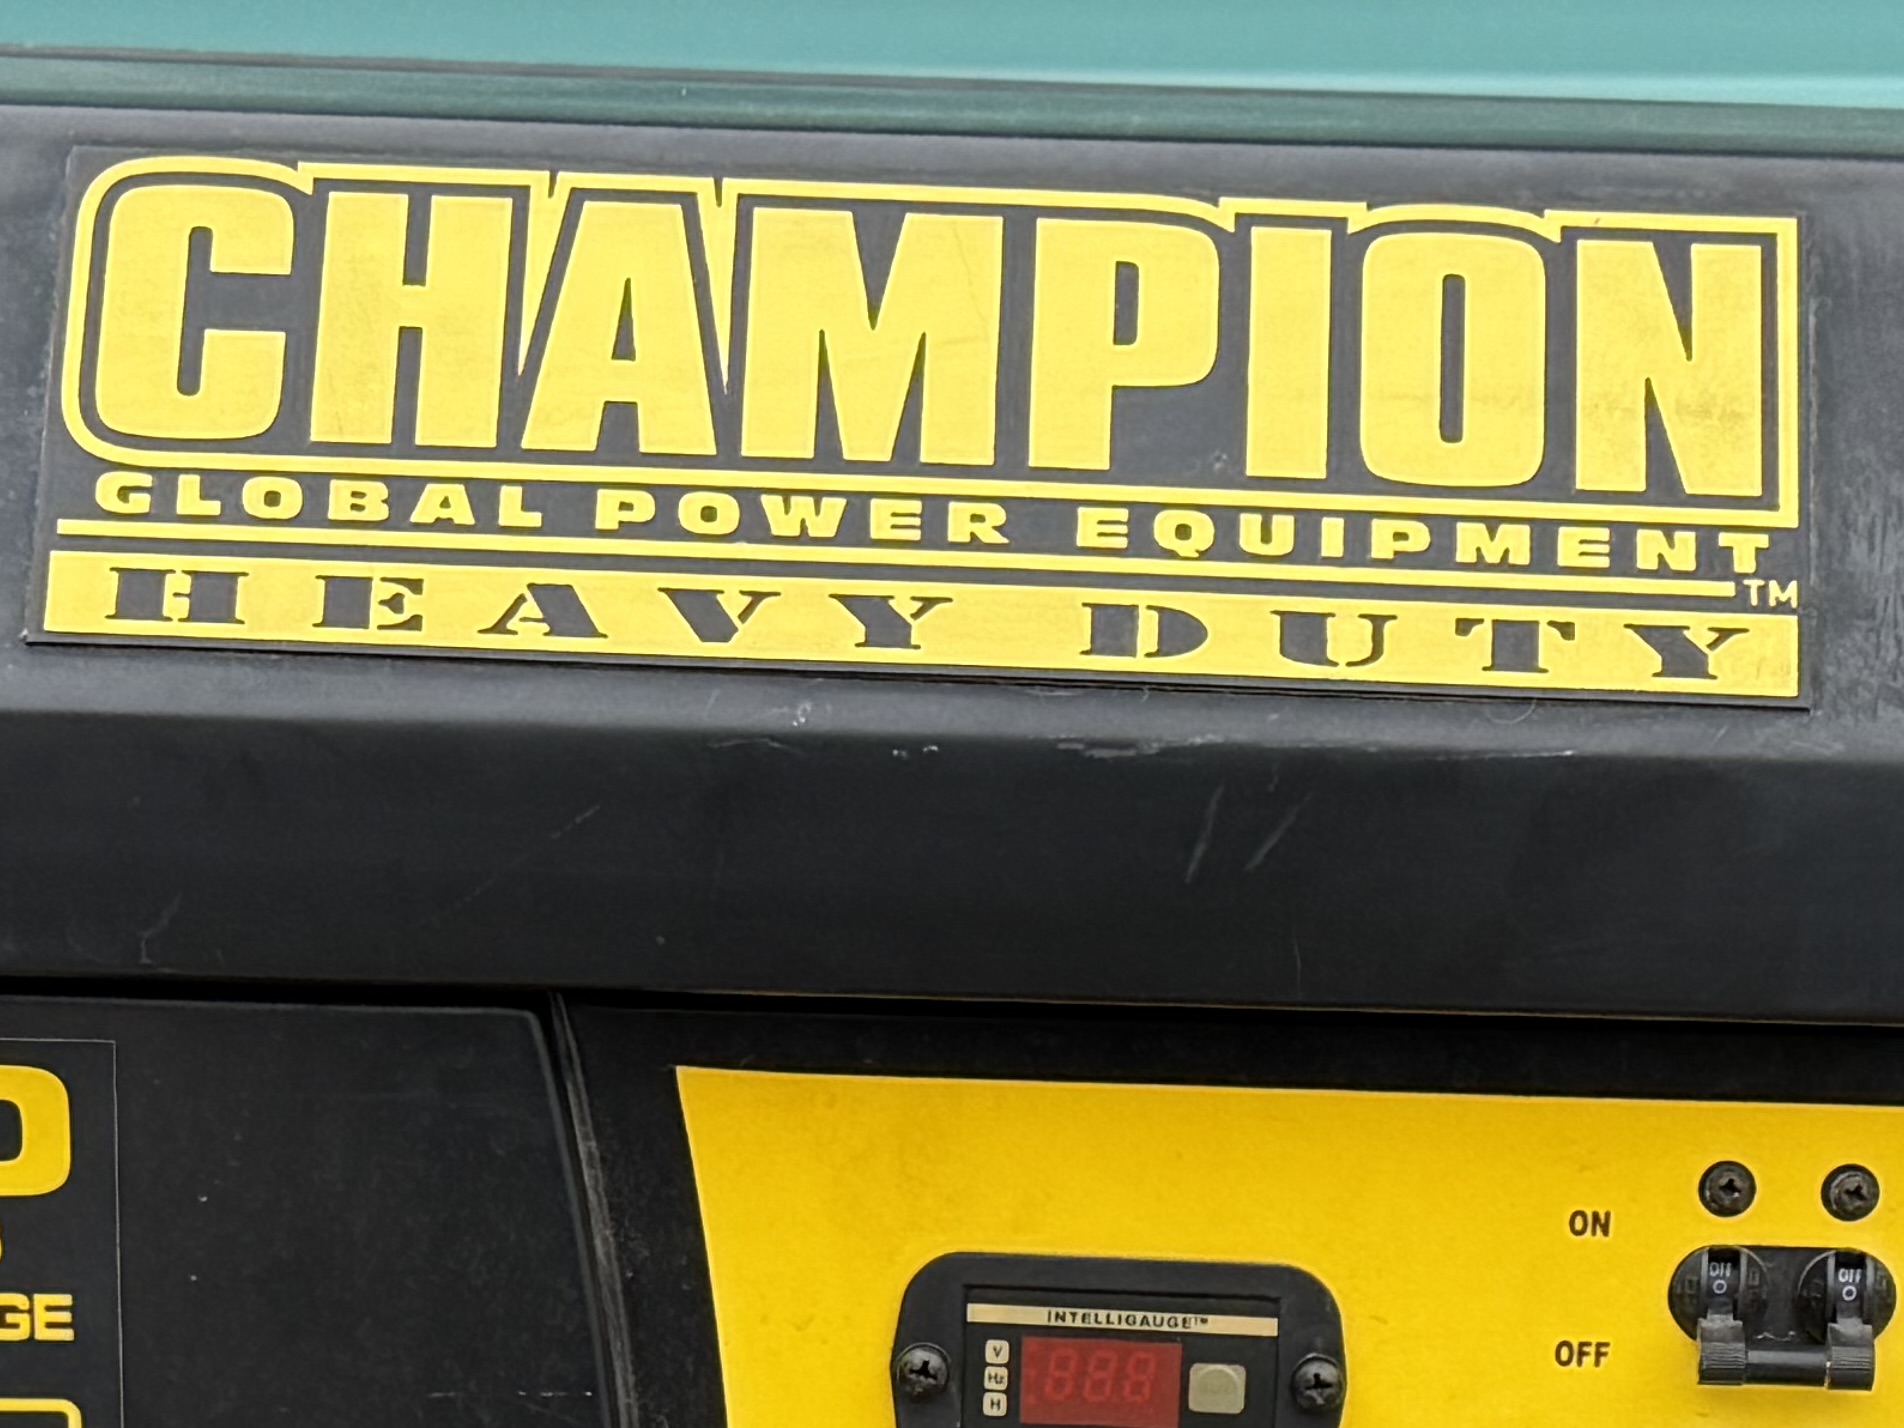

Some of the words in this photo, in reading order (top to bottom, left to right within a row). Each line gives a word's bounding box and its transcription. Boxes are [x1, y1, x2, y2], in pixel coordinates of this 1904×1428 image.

[94, 180, 1780, 501] CHAMPION
[94, 470, 542, 527] GLOBAL
[594, 488, 1009, 544] POWER
[1075, 506, 1769, 573] EQUIPMENT
[105, 566, 953, 650] HEAVY
[1079, 602, 1745, 680] DUTY
[1568, 1211, 1612, 1238] ON
[1555, 1340, 1610, 1368] OFF
